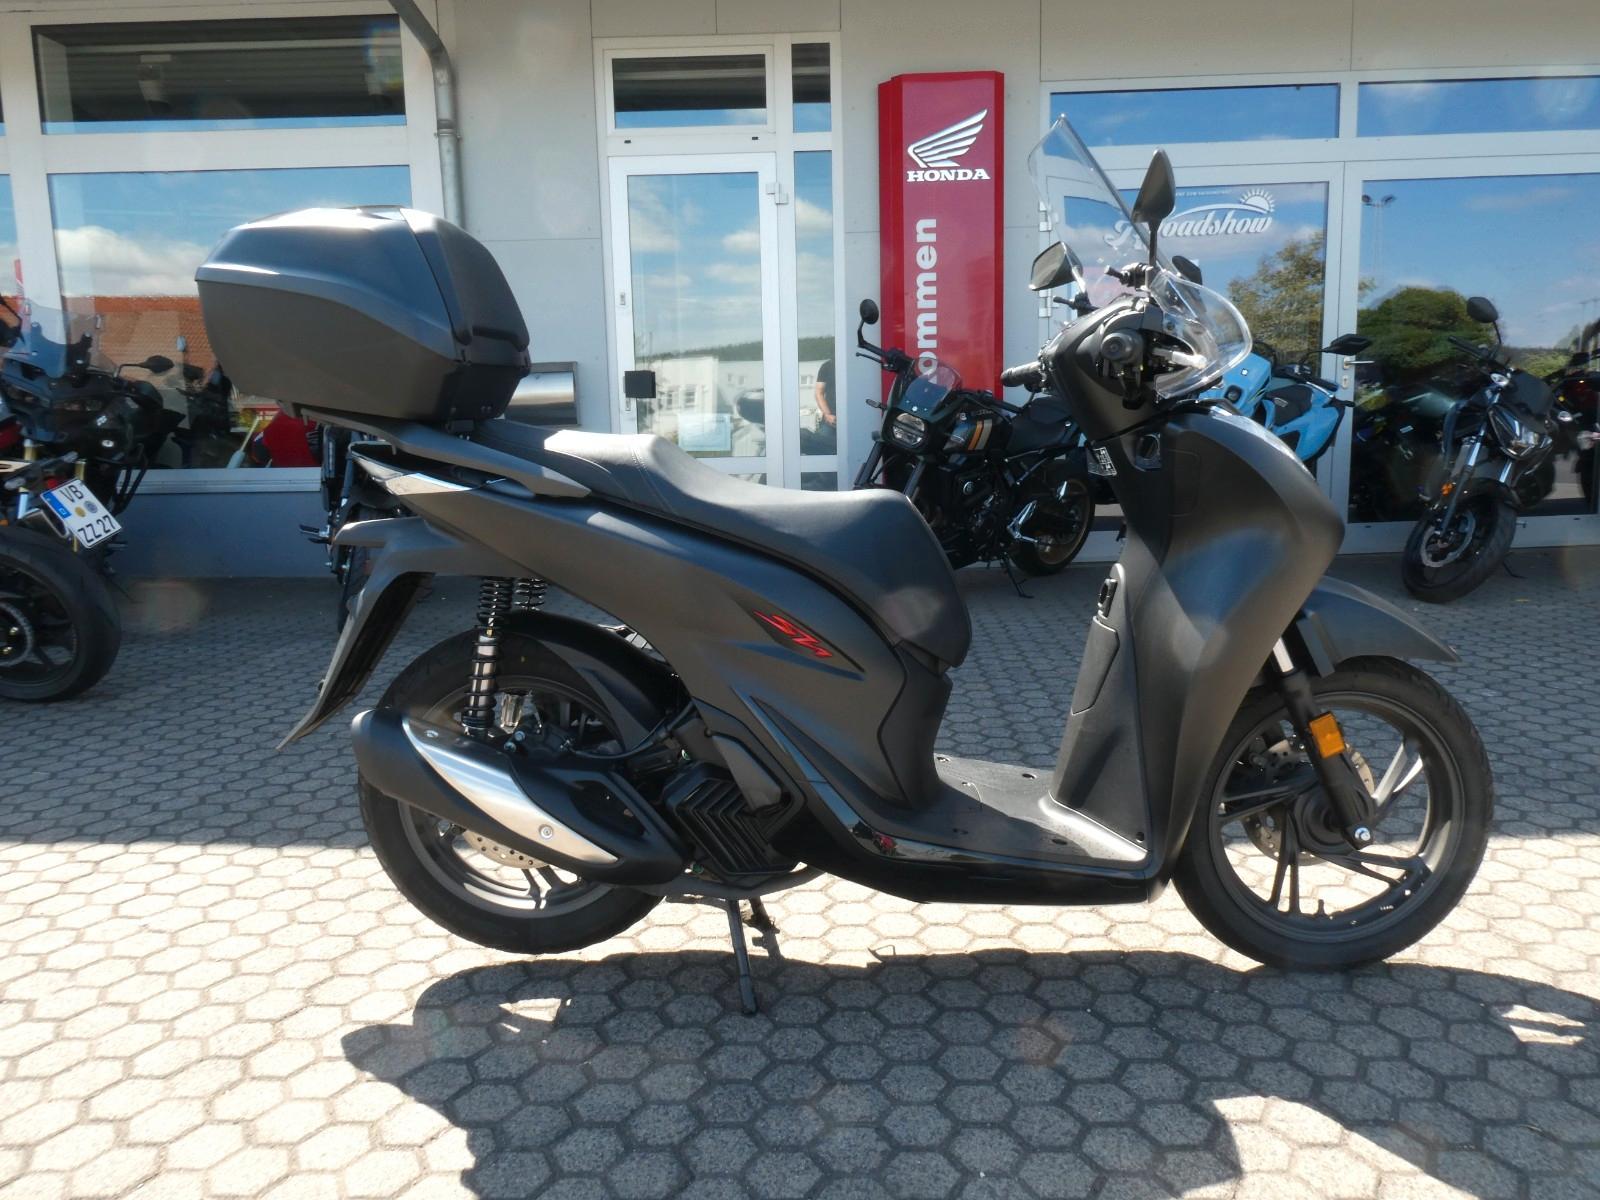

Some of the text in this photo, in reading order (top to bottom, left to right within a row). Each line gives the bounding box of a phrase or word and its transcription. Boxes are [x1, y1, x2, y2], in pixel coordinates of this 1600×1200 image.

[907, 168, 990, 182] HONDA
[916, 218, 937, 384] ommen
[60, 484, 84, 503] VB
